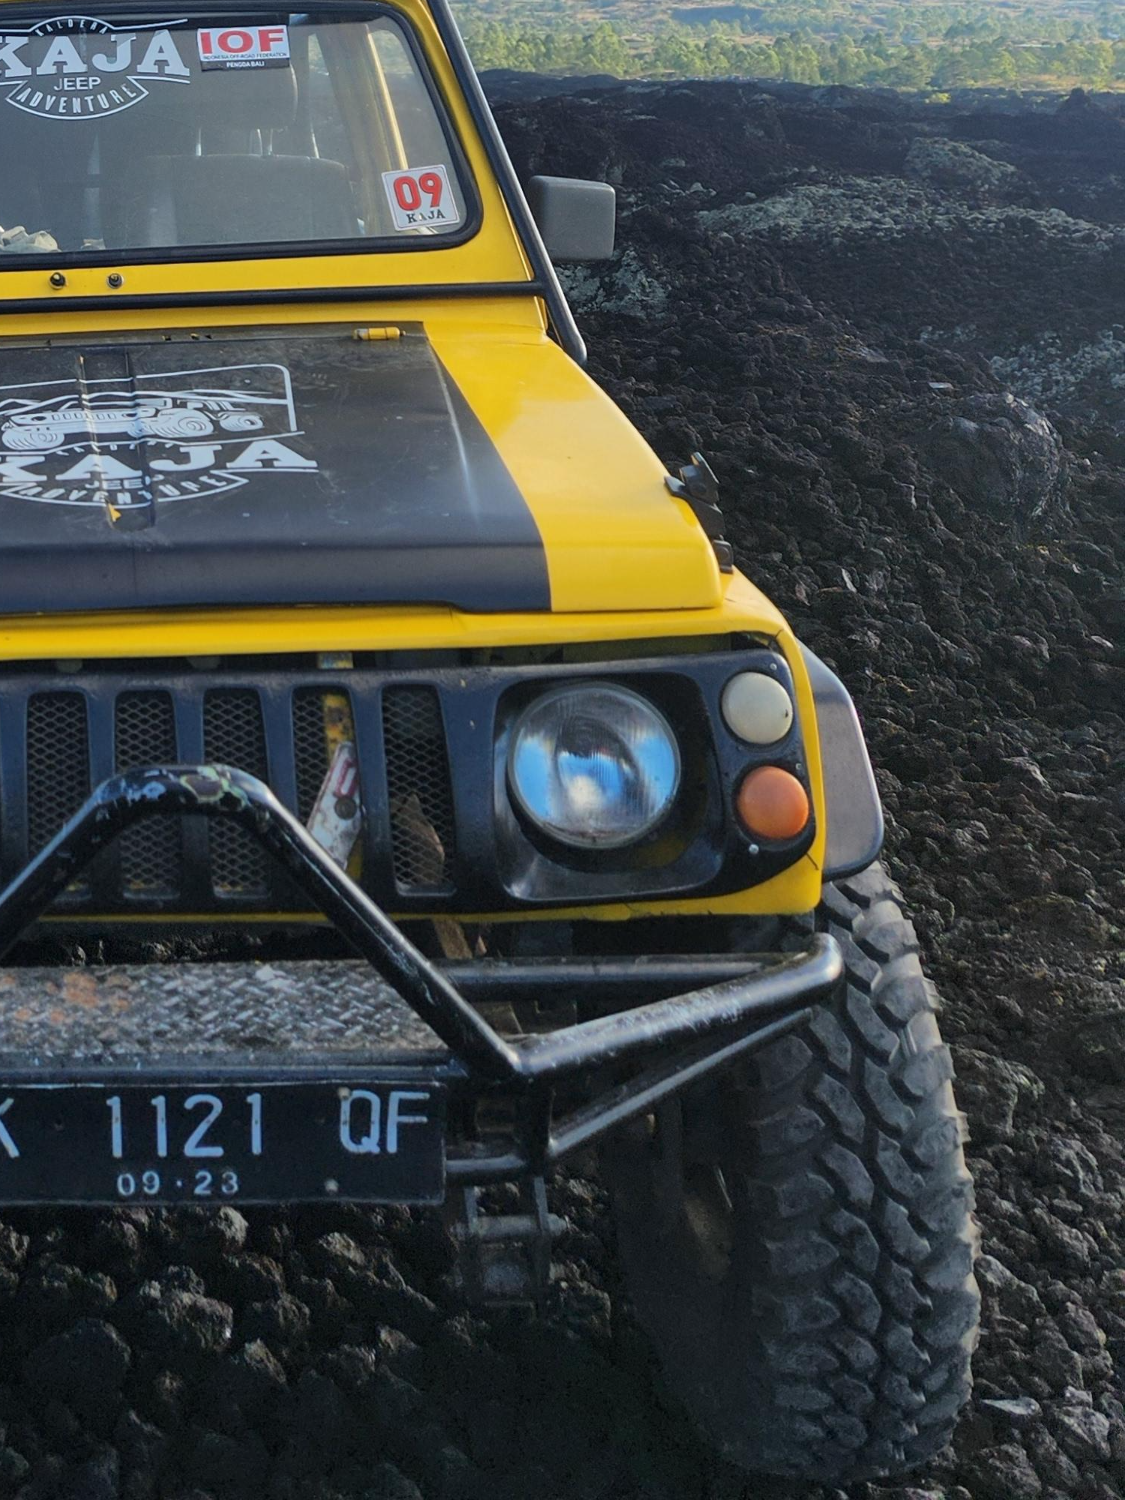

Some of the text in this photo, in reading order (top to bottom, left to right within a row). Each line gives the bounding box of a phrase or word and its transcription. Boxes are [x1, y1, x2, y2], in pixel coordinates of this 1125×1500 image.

[34, 18, 109, 37] KALDERA
[200, 29, 284, 54] IOF
[15, 82, 137, 114] ADVENTURE
[53, 76, 102, 92] JEEP
[393, 172, 443, 211] 09
[406, 208, 446, 224] KAJA
[19, 474, 228, 505] ADVENTURE
[106, 1093, 263, 1159] 1121
[339, 1090, 431, 1154] QF
